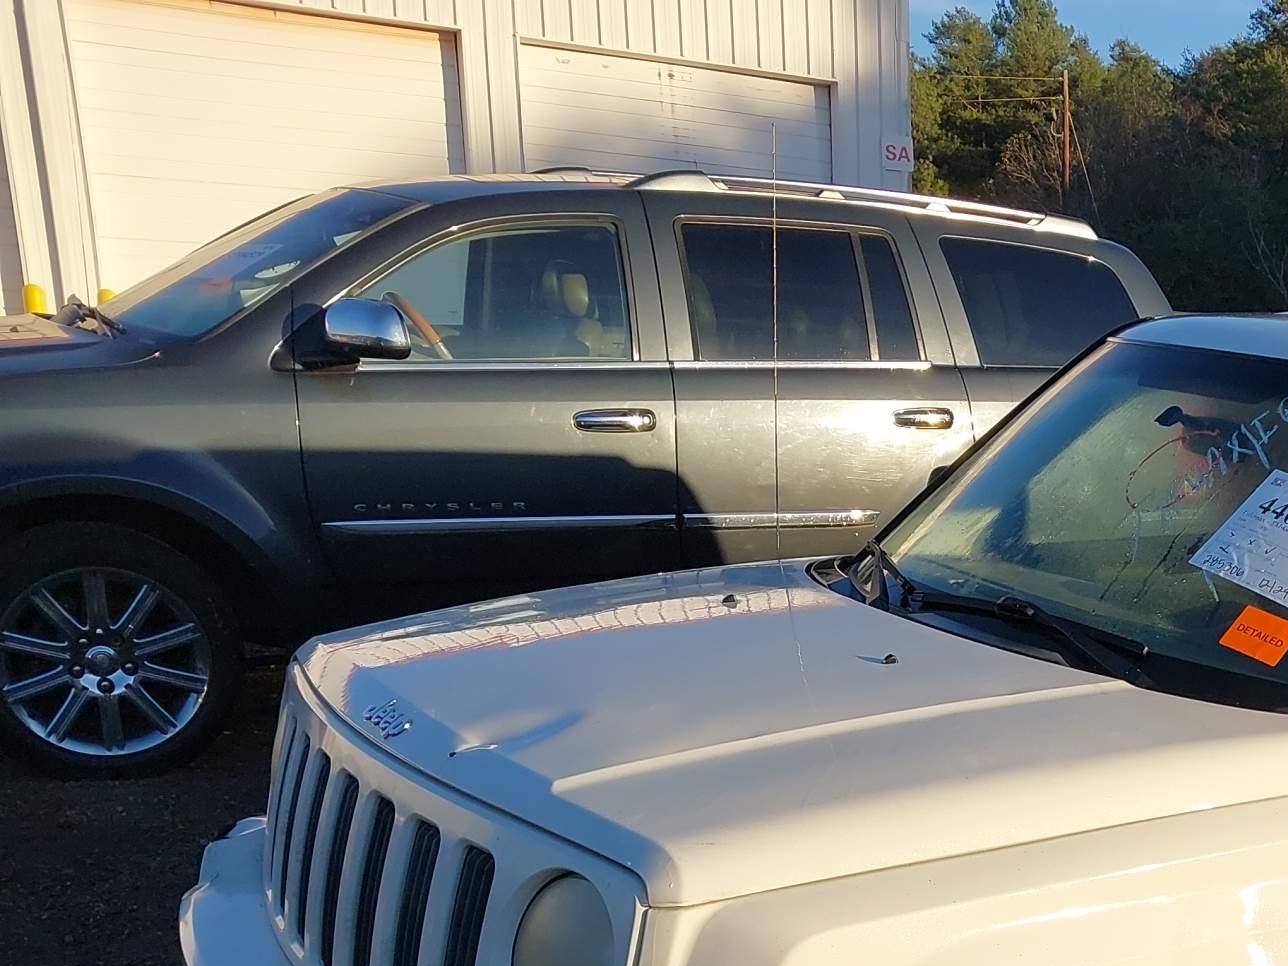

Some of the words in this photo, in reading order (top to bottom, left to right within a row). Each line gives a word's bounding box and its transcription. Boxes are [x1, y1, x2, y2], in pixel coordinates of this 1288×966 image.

[885, 144, 911, 162] SA
[353, 502, 527, 512] CHRYSLER
[1236, 623, 1284, 648] DETAILED
[363, 698, 412, 740] Jeep
